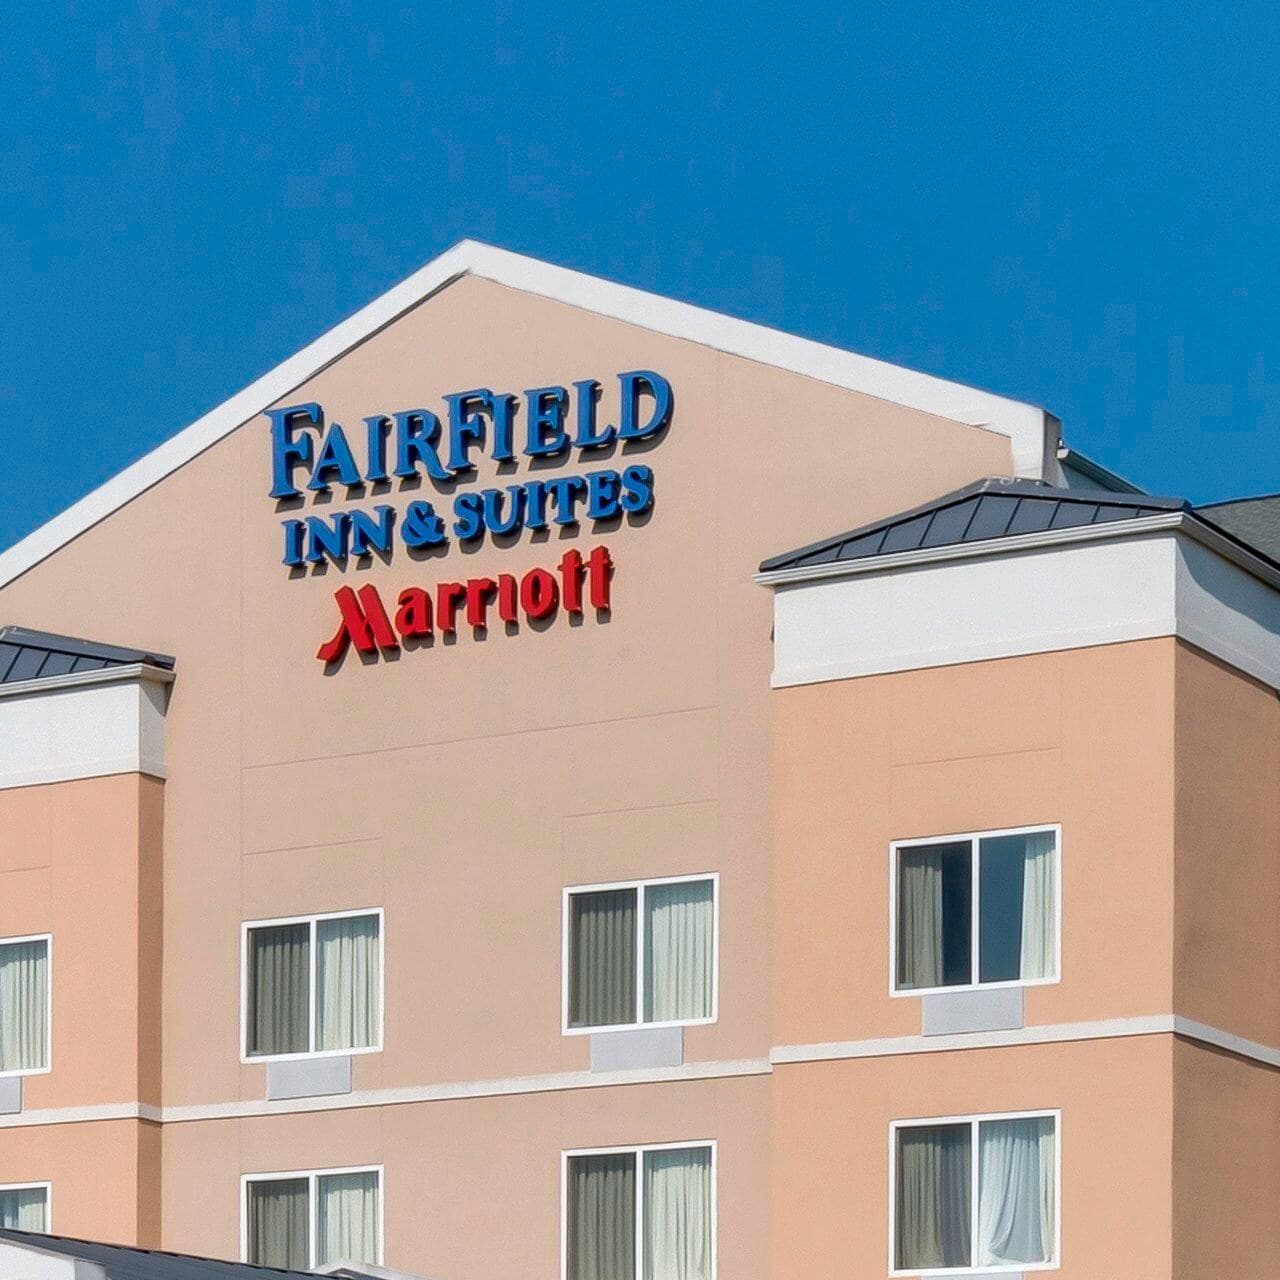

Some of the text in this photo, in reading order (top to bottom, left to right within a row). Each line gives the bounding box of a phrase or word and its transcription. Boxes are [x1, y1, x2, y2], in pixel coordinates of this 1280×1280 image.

[265, 370, 675, 500] FAIRFIELD
[281, 464, 654, 566] INN & SUITES
[317, 545, 613, 662] Marriott
